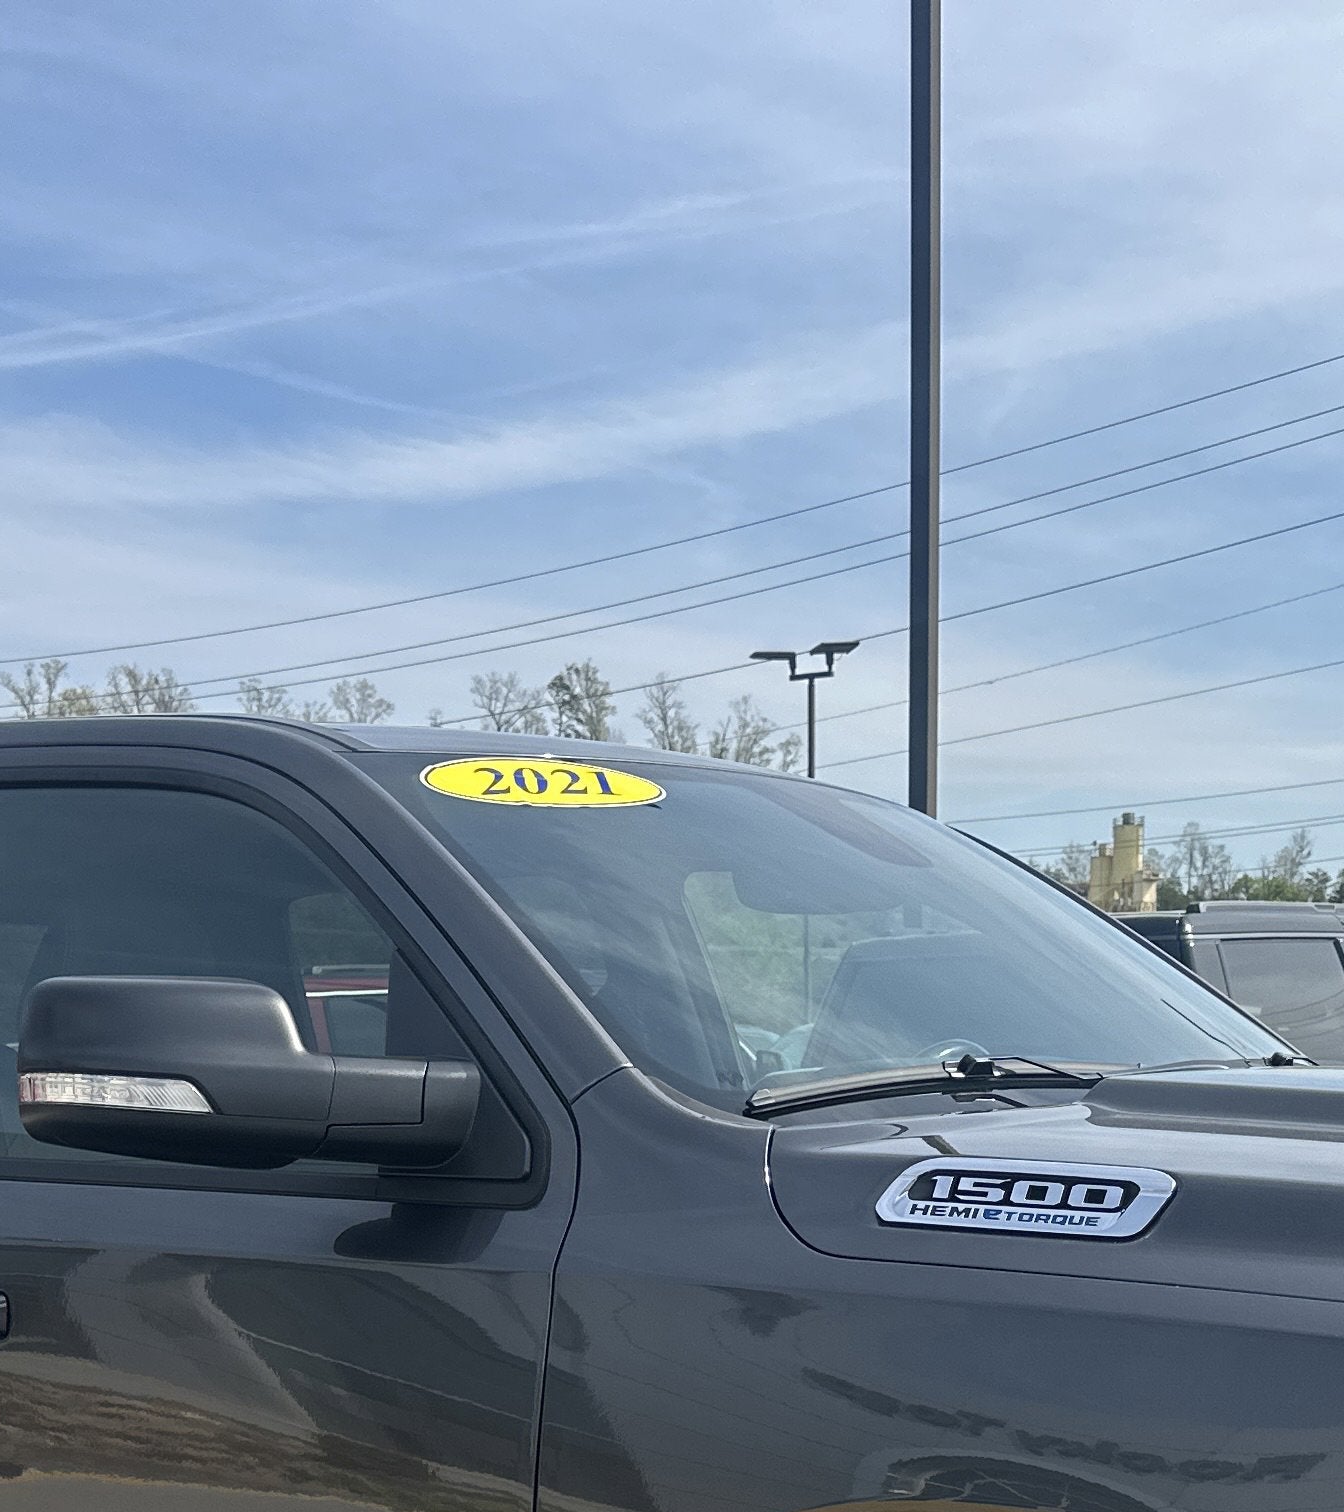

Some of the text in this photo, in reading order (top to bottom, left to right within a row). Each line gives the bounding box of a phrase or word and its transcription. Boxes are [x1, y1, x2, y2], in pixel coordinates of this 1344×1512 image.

[474, 767, 622, 796] 2021
[931, 1175, 1124, 1210] 1500
[909, 1203, 979, 1219] HEMI
